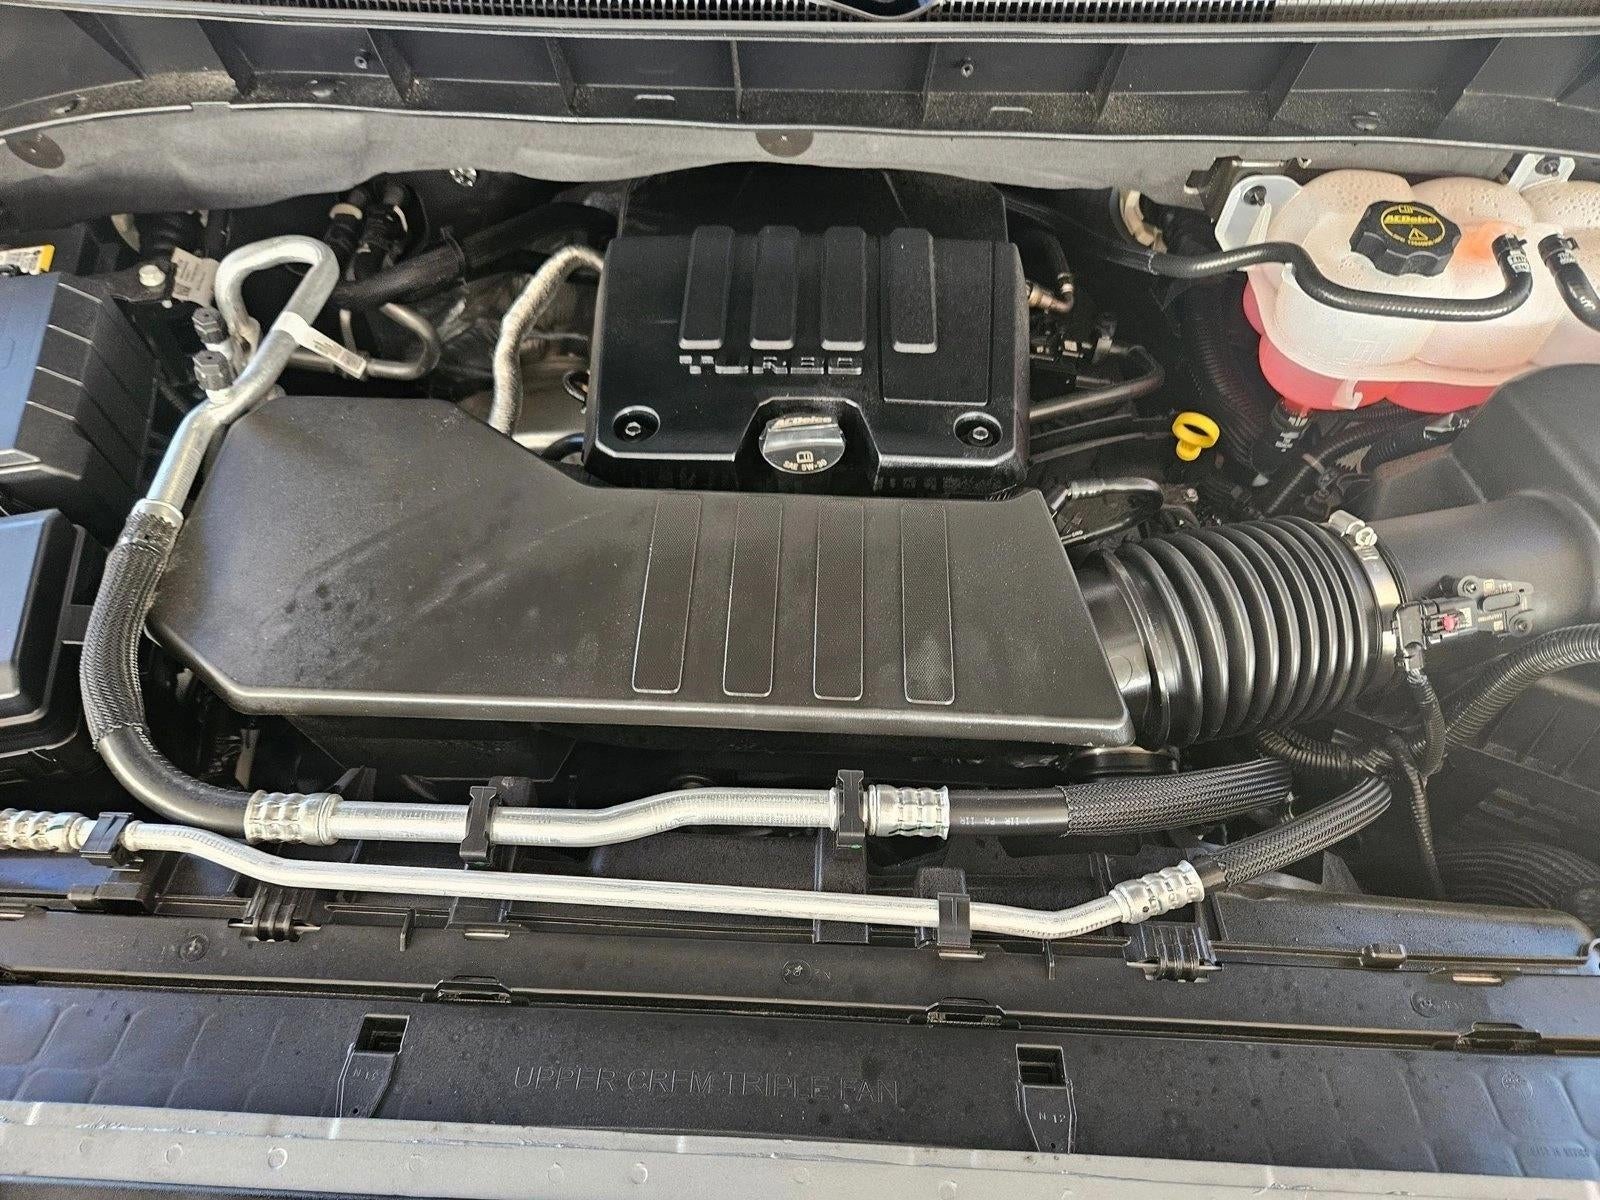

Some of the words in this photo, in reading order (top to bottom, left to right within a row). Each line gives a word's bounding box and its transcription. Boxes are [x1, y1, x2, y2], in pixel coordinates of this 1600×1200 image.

[513, 1066, 619, 1092] UPPER
[722, 1071, 831, 1101] TRIPLE
[839, 1076, 900, 1104] FAN
